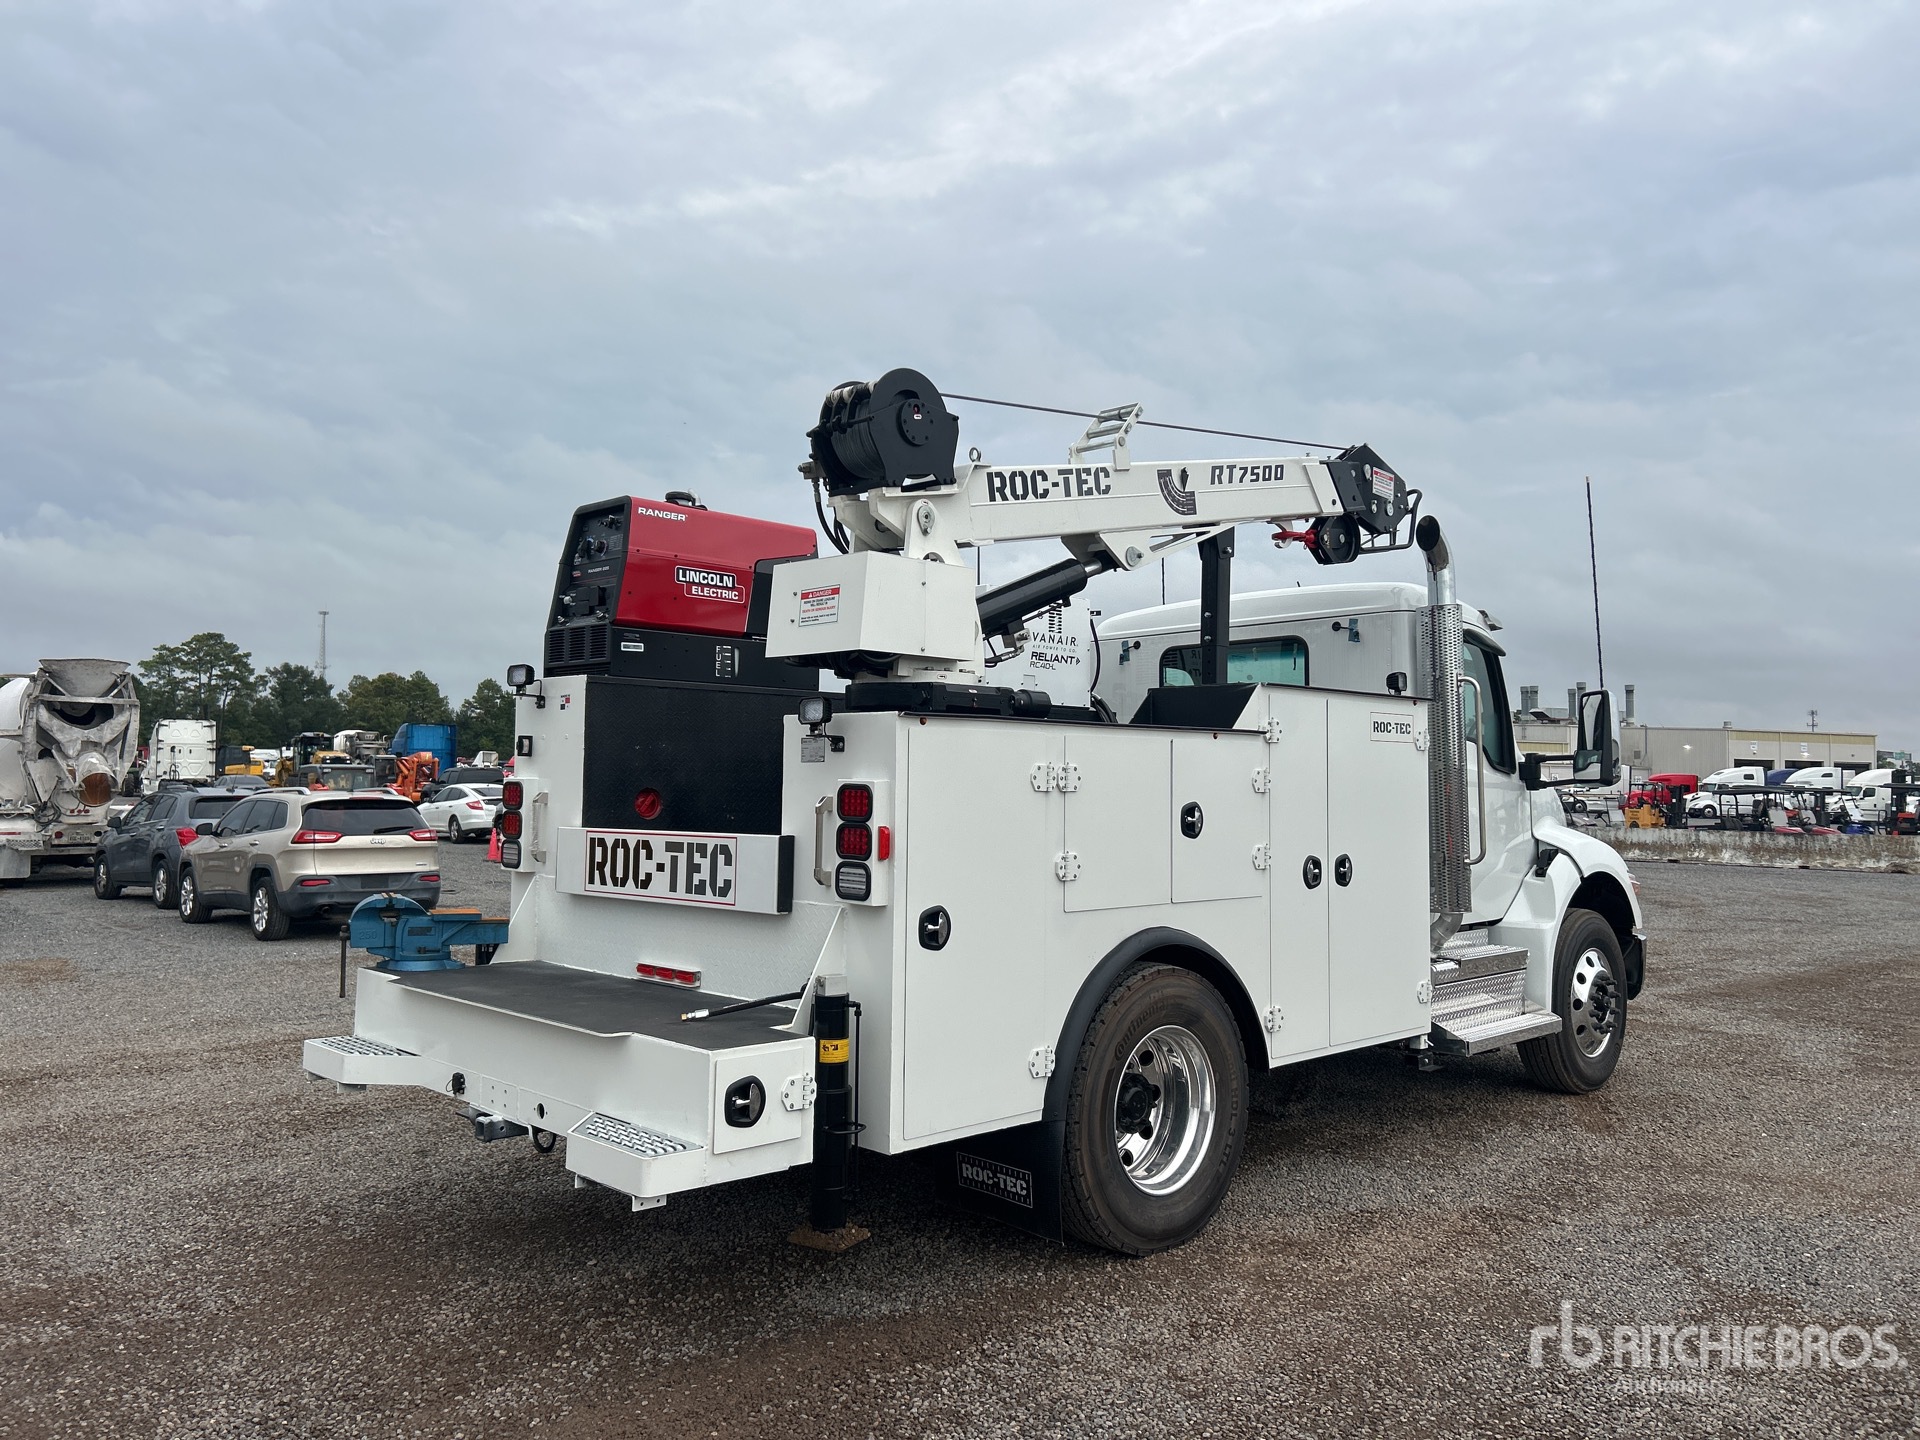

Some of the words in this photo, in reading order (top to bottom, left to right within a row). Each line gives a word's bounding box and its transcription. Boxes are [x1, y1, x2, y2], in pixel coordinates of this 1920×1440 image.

[1210, 464, 1285, 486] RT7500
[987, 467, 1112, 502] ROC-TEC
[638, 507, 686, 521] RANGER
[679, 569, 733, 587] LINCOLN
[691, 586, 739, 600] ELECTRIC
[1033, 632, 1077, 646] VANAIR
[1031, 651, 1075, 665] RELIANT
[1373, 720, 1411, 735] ROC-TEC
[588, 837, 732, 898] ROC-TEC
[961, 1162, 1028, 1197] ROC-TEC
